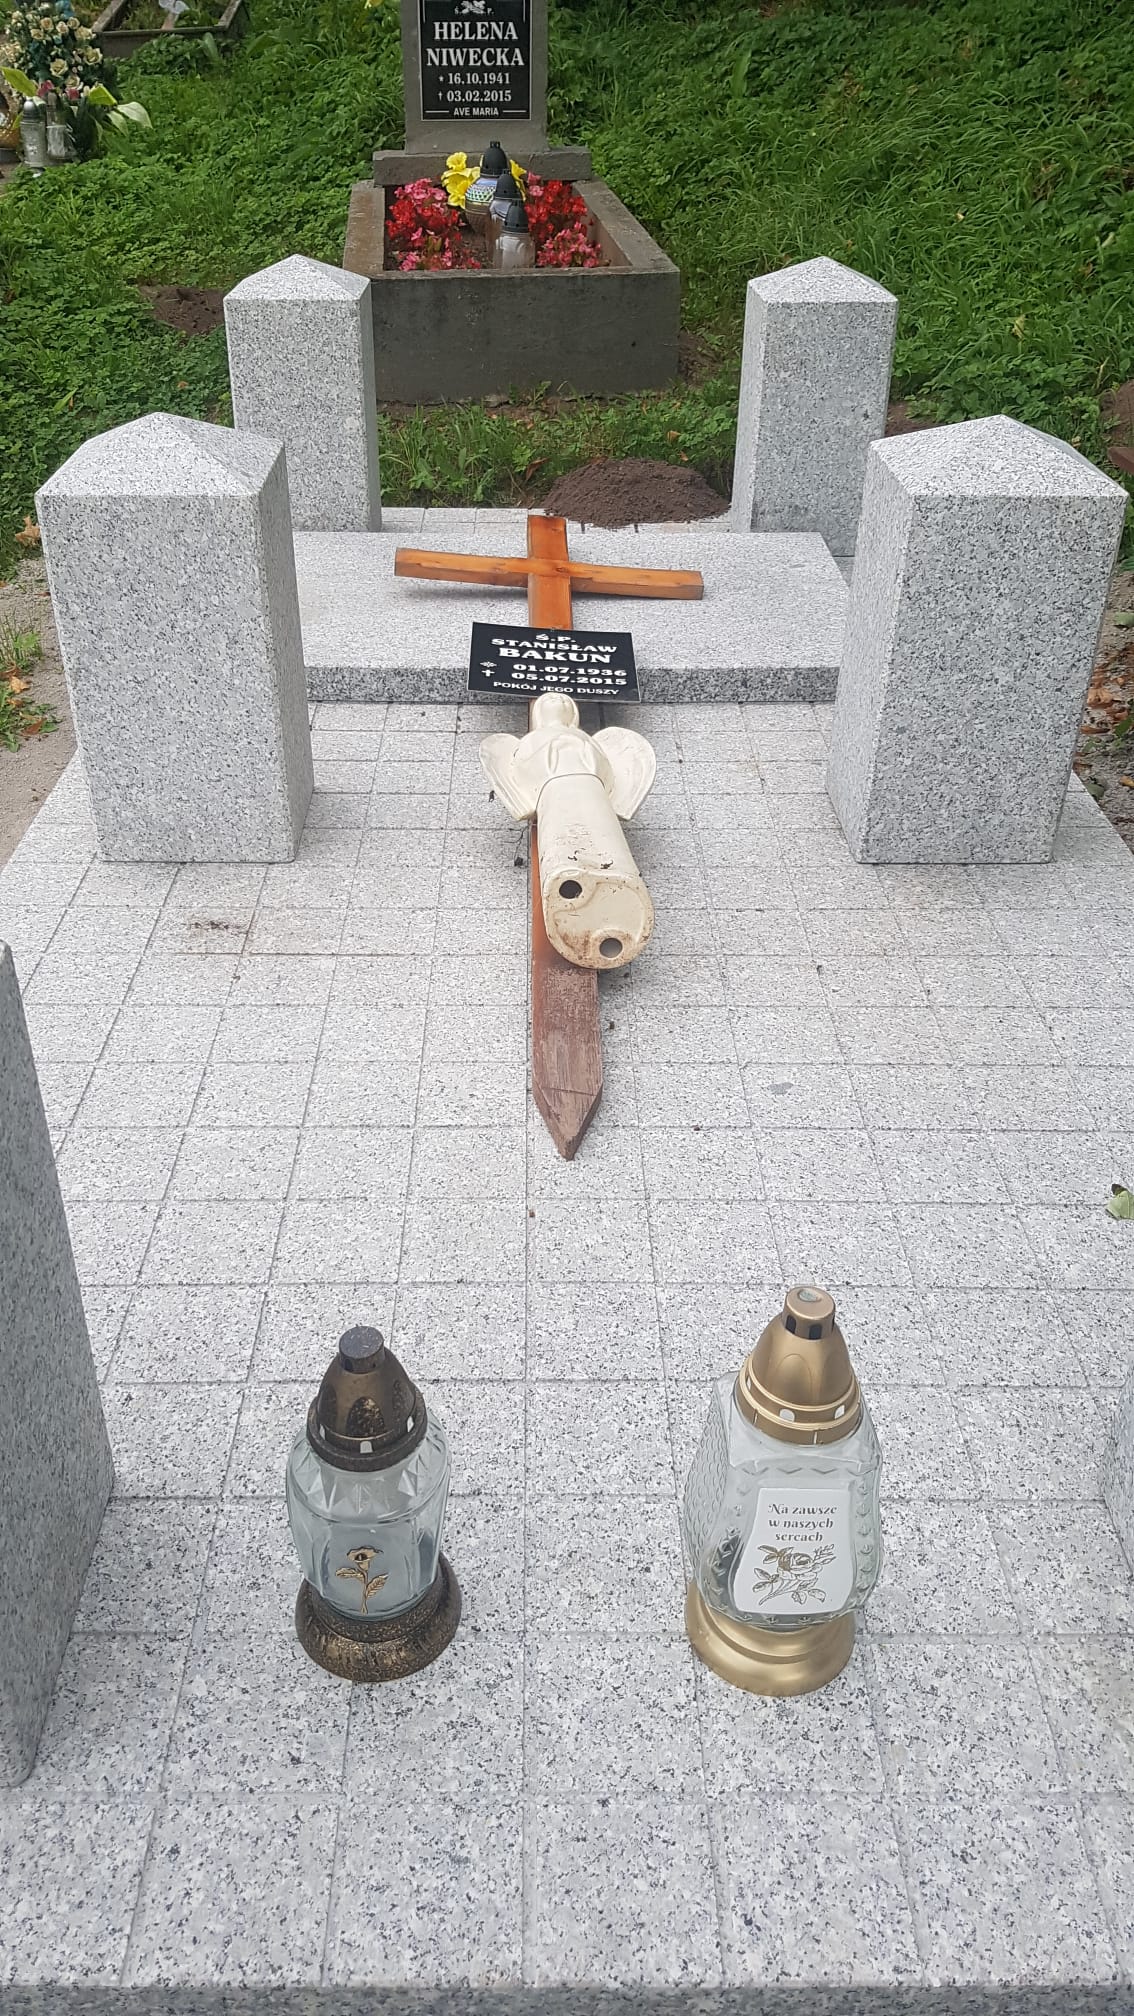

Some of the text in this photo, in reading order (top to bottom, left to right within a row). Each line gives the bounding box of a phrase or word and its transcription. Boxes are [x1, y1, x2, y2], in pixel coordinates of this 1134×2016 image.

[433, 21, 518, 40] HELENA
[426, 48, 524, 66] NIWECKA
[448, 73, 510, 84] 16.10.1941
[446, 90, 512, 101] 03.02.2015
[453, 107, 499, 116] AVE MARIA
[491, 638, 617, 653] STANISŁAW
[499, 648, 611, 664] BAKUN
[513, 664, 627, 677] 01.07.1936
[511, 672, 627, 685] 05.07.2015
[493, 681, 619, 695] POKÓJ JEGO DUSZY
[768, 1503, 837, 1515] Na zawsze
[769, 1518, 833, 1530] w naszych
[775, 1532, 823, 1542] sercach
